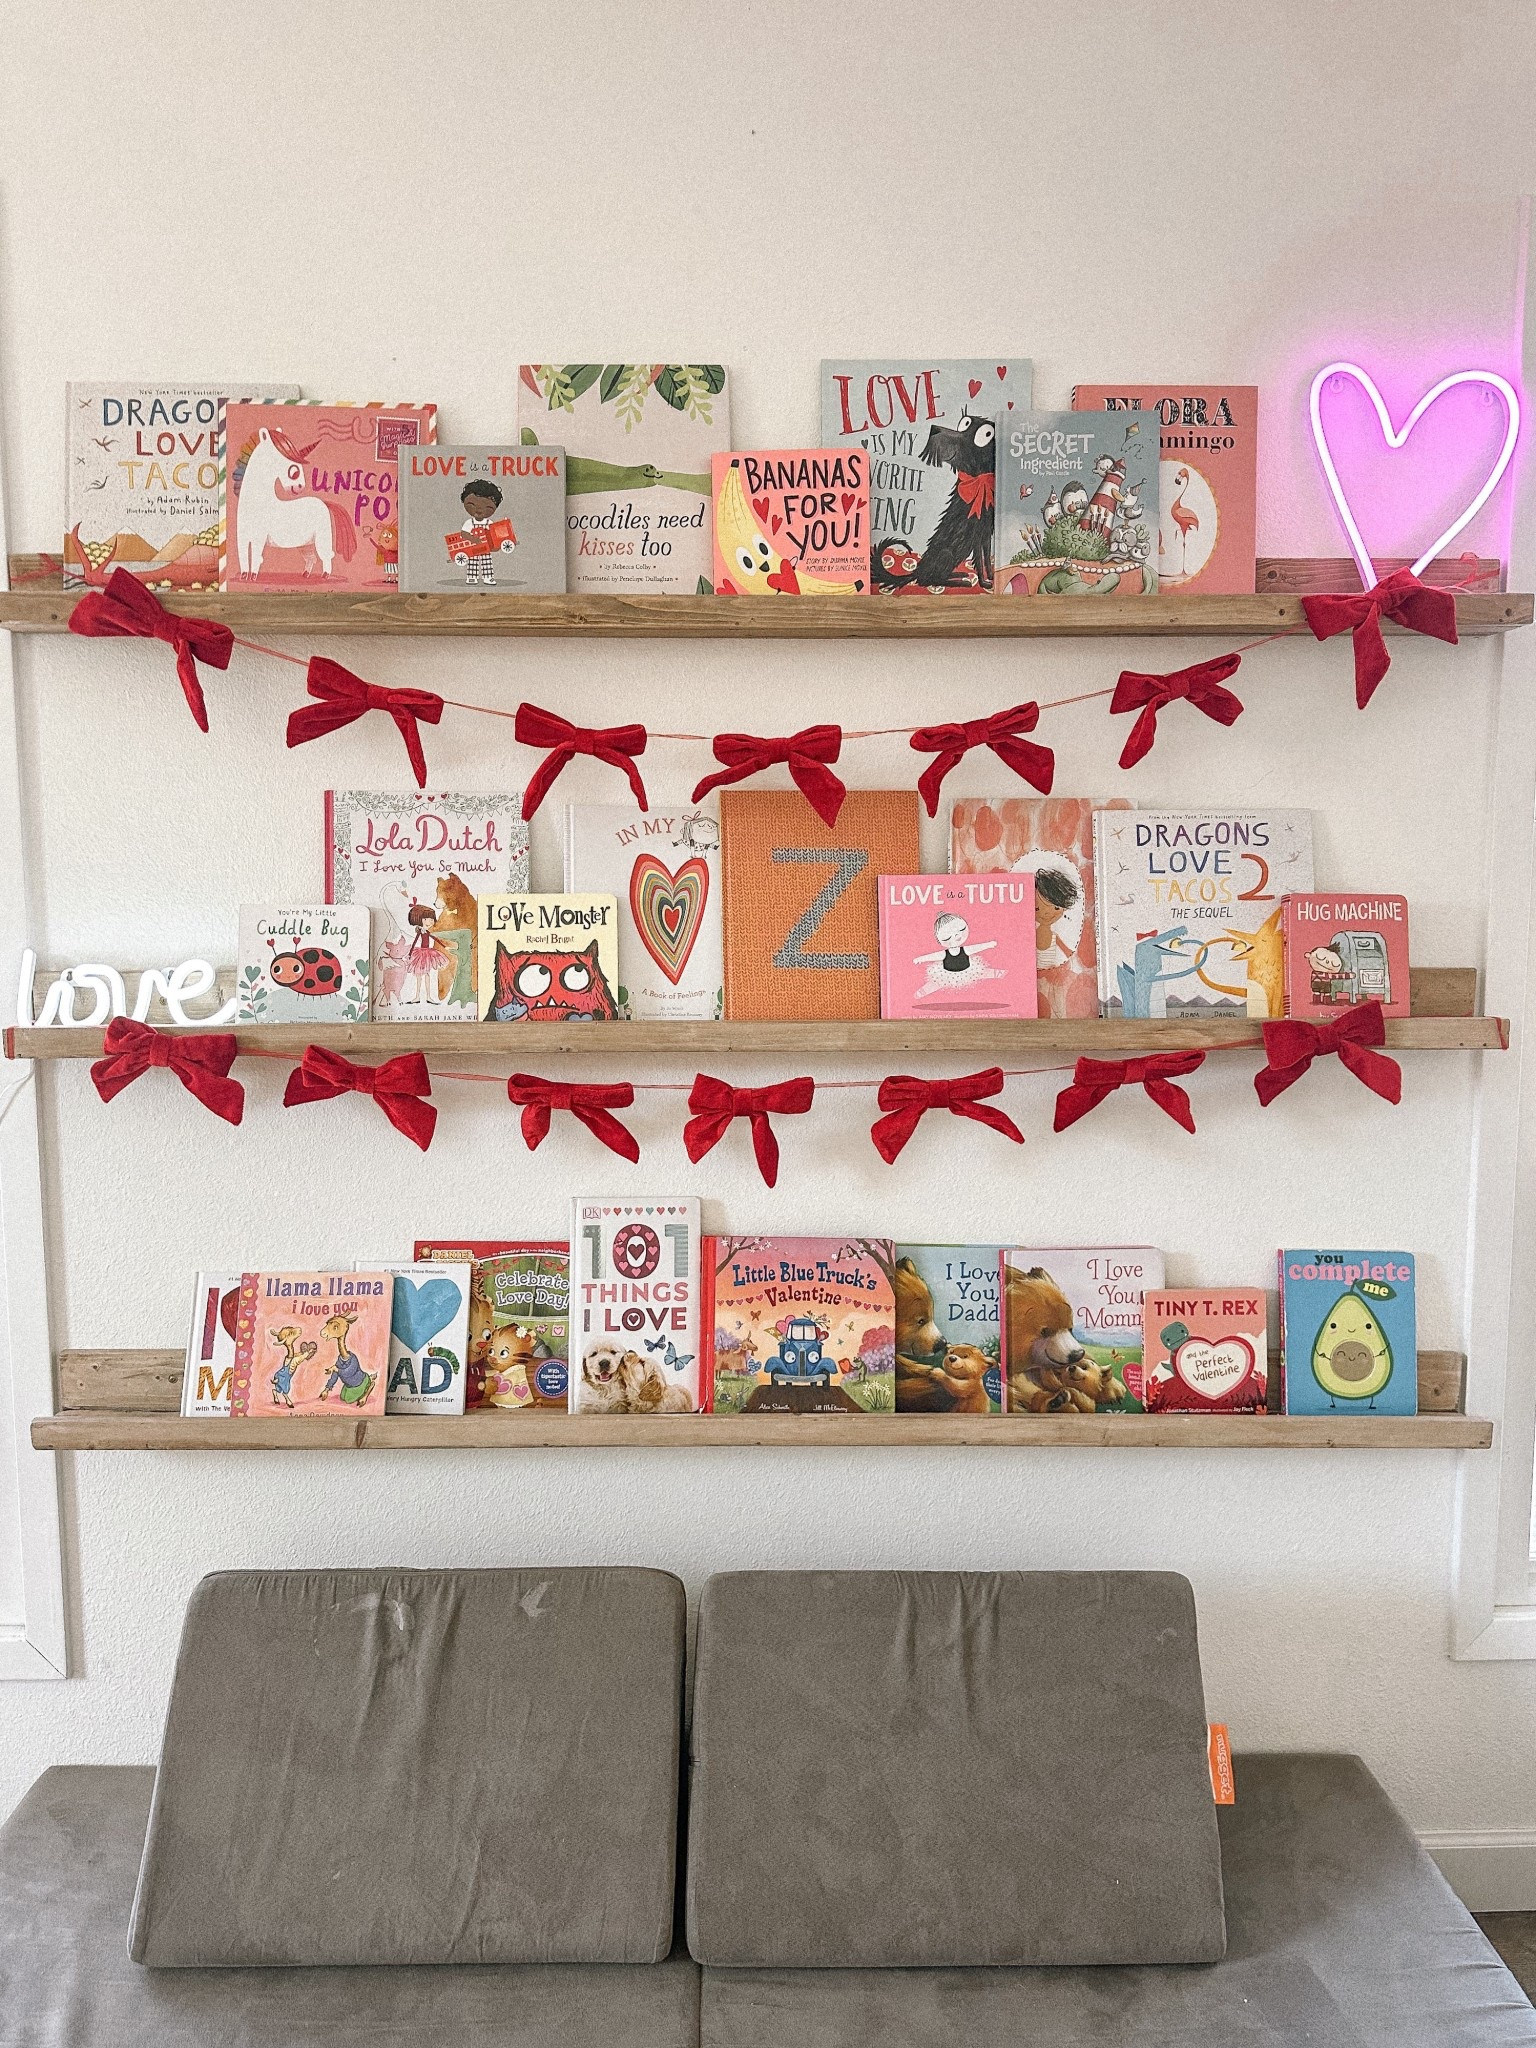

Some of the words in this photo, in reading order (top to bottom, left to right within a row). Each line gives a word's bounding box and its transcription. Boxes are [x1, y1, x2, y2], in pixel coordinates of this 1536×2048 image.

[103, 398, 215, 426] DRAGO
[832, 369, 946, 436] LOVE
[1020, 422, 1039, 433] The
[870, 432, 884, 456] IS
[891, 430, 918, 457] MY
[1010, 431, 1095, 458] SECRET
[412, 455, 467, 476] LOVE
[470, 462, 479, 471] is
[487, 455, 559, 476] TRUCK
[744, 455, 861, 494] BANANAS
[1020, 455, 1083, 475] Ingredient
[312, 468, 398, 494] UNICO
[157, 496, 181, 504] Adam
[185, 495, 209, 504] Rubin
[170, 505, 195, 515] Daniel
[784, 493, 837, 525] FOR
[657, 502, 706, 529] need
[578, 531, 634, 556] kisses
[641, 531, 672, 556] too
[786, 513, 860, 560] YOU!
[356, 818, 414, 857] Lola
[415, 814, 502, 852] Dutch
[615, 824, 640, 846] IN
[642, 818, 676, 836] MY
[1136, 822, 1270, 847] DRAGONS
[359, 861, 368, 872] I
[373, 860, 406, 873] Love
[408, 860, 434, 878] You
[439, 860, 452, 873] So
[455, 859, 496, 872] Much
[1149, 850, 1232, 875] LOVE
[1147, 877, 1232, 904] TACOS
[1237, 853, 1275, 901] 2
[890, 884, 944, 906] LOVE
[947, 889, 956, 899] is
[958, 891, 965, 899] a
[964, 883, 1024, 904] TUTU
[302, 909, 313, 917] My
[315, 909, 336, 917] Little
[538, 905, 611, 930] Monster
[771, 848, 869, 969] Z
[1171, 908, 1191, 919] THE
[1194, 906, 1234, 919] SEQUEL
[1298, 901, 1331, 921] HUG
[1334, 901, 1403, 921] MACHINE
[257, 919, 312, 935] Cuddle
[321, 918, 349, 947] Bug
[526, 935, 549, 944] Rachel
[17, 949, 237, 1027] love
[649, 990, 667, 1000] Book
[669, 992, 676, 1000] of
[583, 1208, 601, 1219] DK
[432, 1250, 473, 1260] DANIEL
[582, 1224, 689, 1279] 101
[1314, 1254, 1344, 1265] you
[496, 1270, 569, 1290] Celebrate
[732, 1263, 776, 1287] Little
[779, 1261, 814, 1283] Blue
[816, 1261, 877, 1290] Truck's
[946, 1263, 952, 1280] I
[1087, 1259, 1099, 1280] I
[1104, 1259, 1143, 1281] Love
[1288, 1260, 1411, 1285] complete
[266, 1278, 321, 1298] llama
[330, 1277, 384, 1296] llama
[496, 1290, 532, 1306] Love
[581, 1282, 689, 1303] THINGS
[764, 1284, 842, 1307] Valentine
[956, 1282, 999, 1302] You,
[1098, 1284, 1140, 1306] You,
[1363, 1282, 1389, 1297] me
[291, 1300, 298, 1314] i
[300, 1301, 330, 1316] love
[334, 1301, 358, 1316] you
[1154, 1300, 1197, 1316] TINY
[1202, 1300, 1218, 1316] T.
[1223, 1300, 1258, 1316] REX
[584, 1309, 590, 1332] I
[604, 1307, 687, 1332] LOVE
